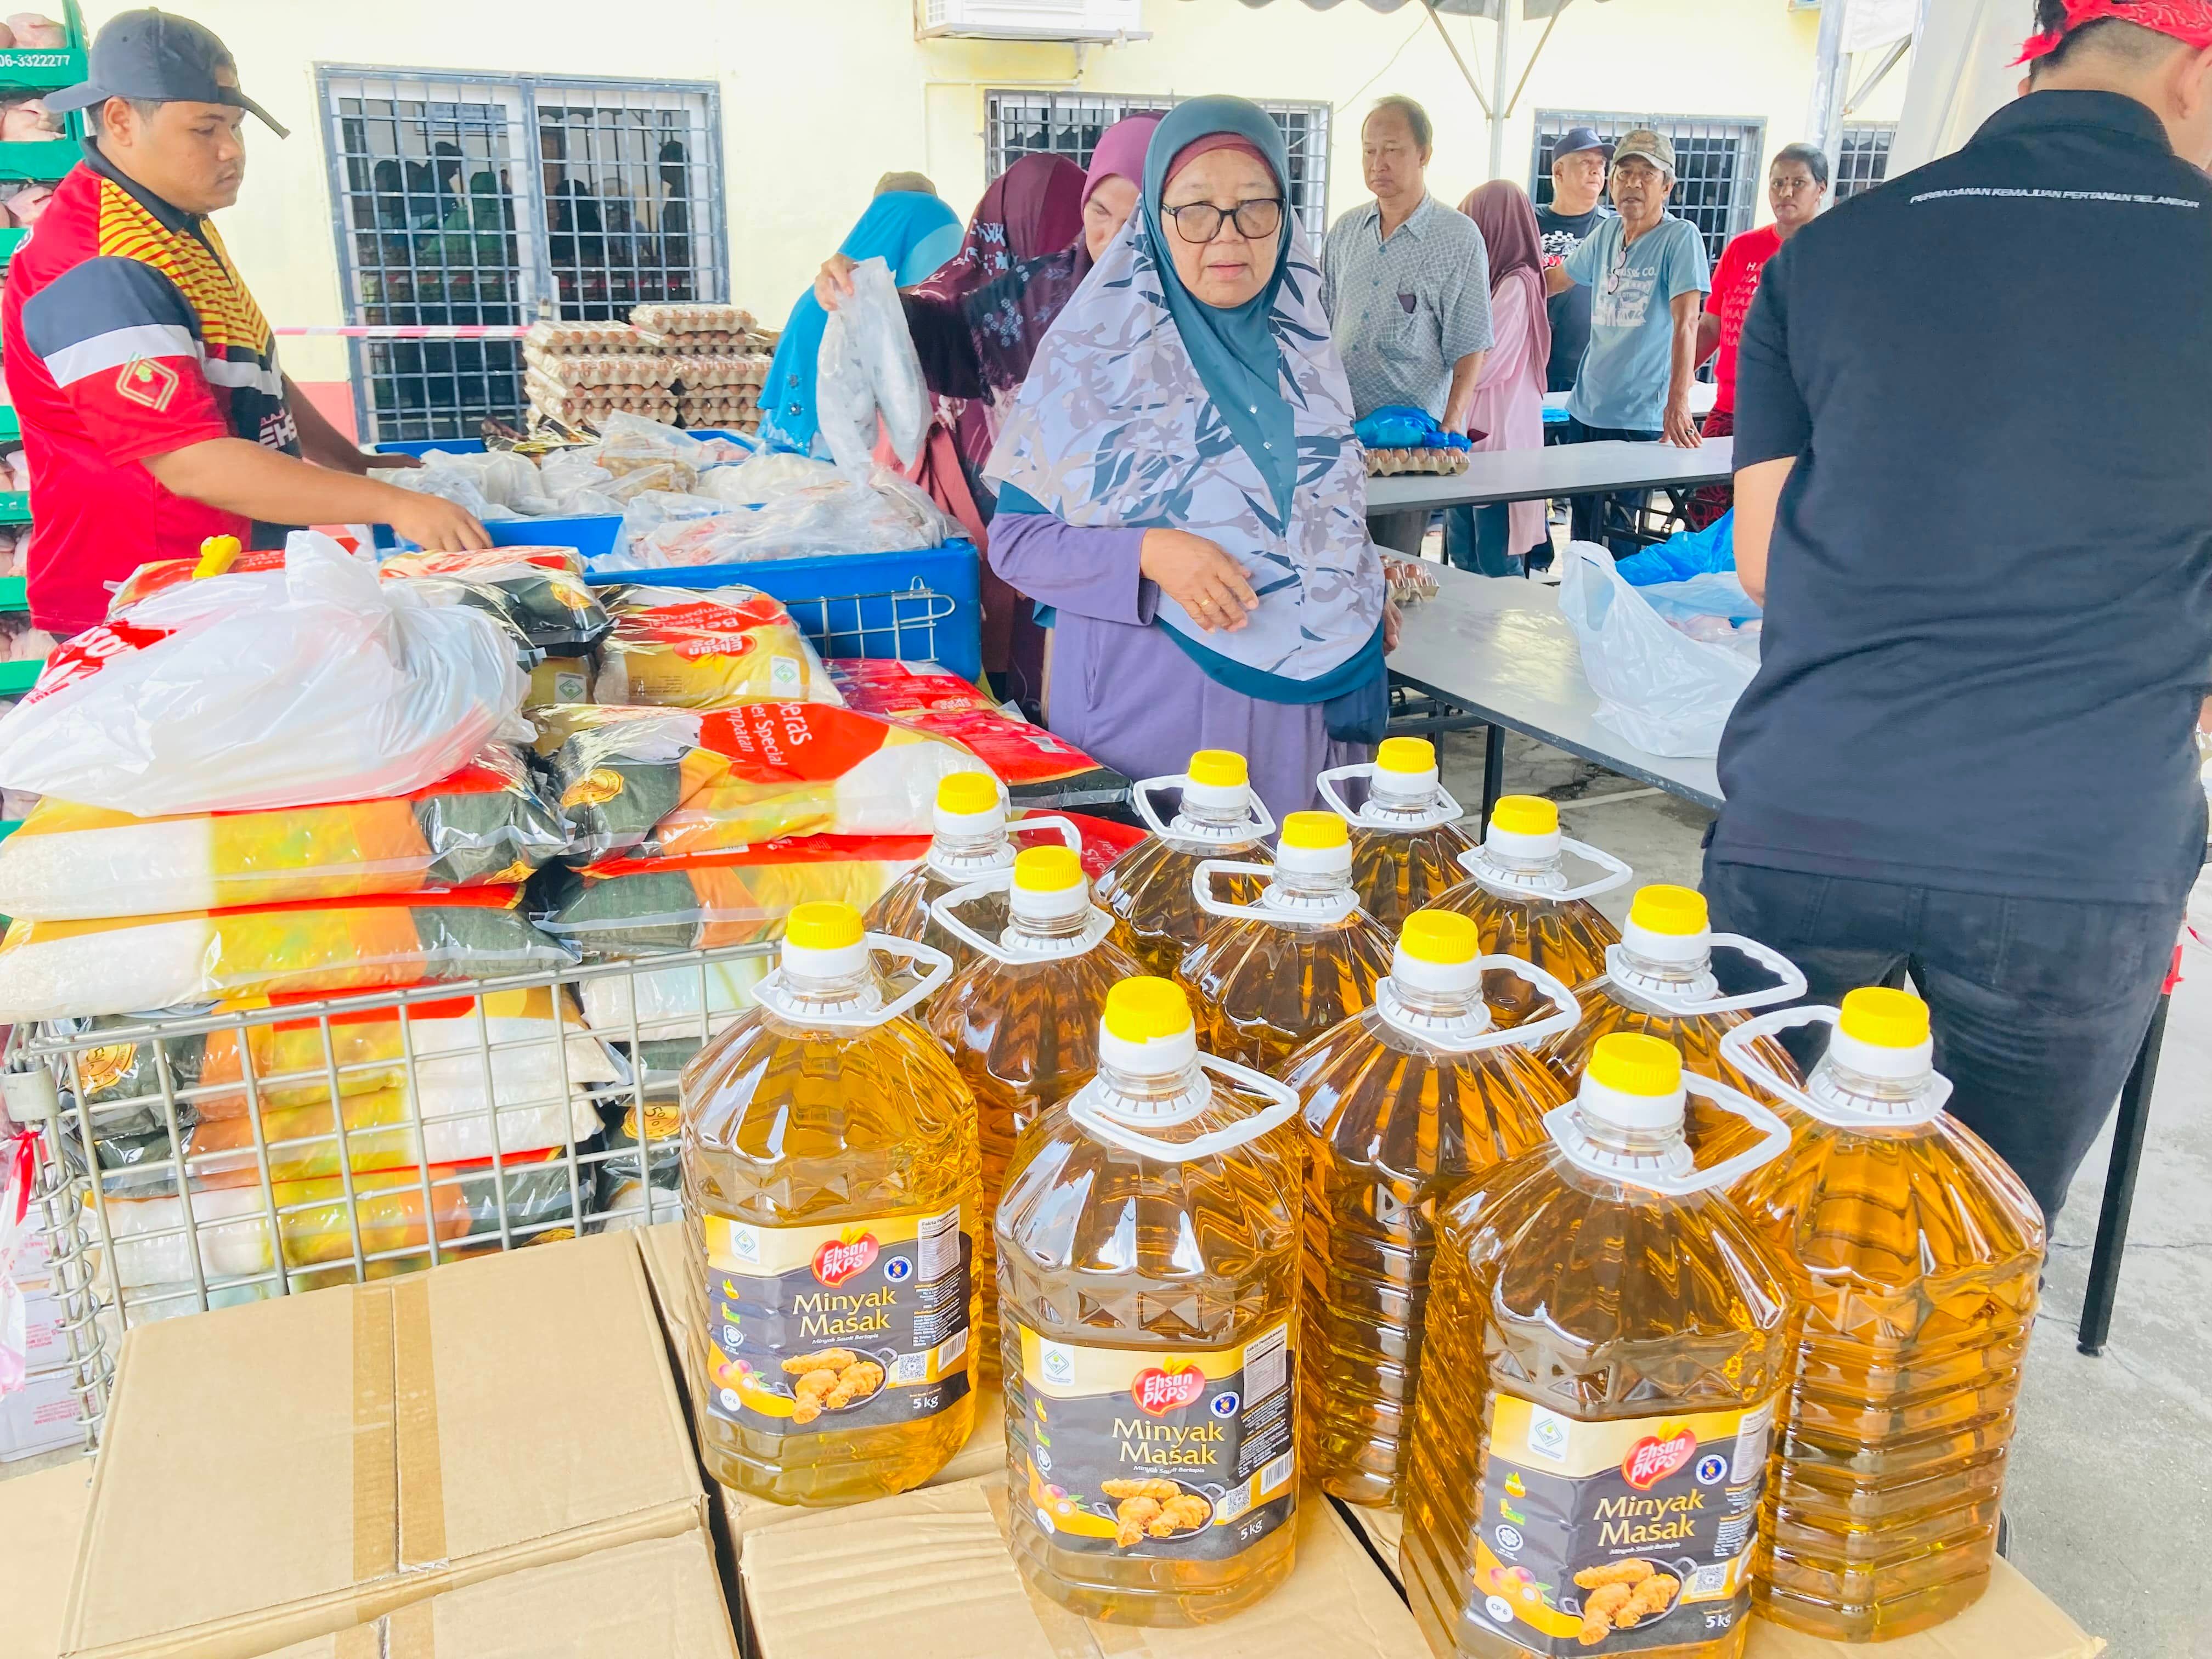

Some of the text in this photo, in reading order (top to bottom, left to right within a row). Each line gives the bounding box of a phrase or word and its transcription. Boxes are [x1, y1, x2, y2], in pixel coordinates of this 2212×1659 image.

[1910, 188, 2200, 208] PERBADANAN KEMAJUAN PERTANIAN SELANGOR
[659, 606, 727, 622] empatan
[688, 640, 743, 656] Ehsan
[751, 703, 788, 766] er Special
[645, 1106, 668, 1126] 5%
[823, 1241, 868, 1264] Ehsan
[822, 1255, 864, 1282] PKPS
[793, 1285, 898, 1316] Minyak
[799, 1308, 891, 1338] Masak
[1144, 1373, 1193, 1392] Ehsan
[913, 1395, 939, 1409] 5 kg
[1142, 1386, 1189, 1408] PKPS
[1111, 1418, 1225, 1448] Minyak
[1119, 1441, 1218, 1465] Masak
[1634, 1437, 1686, 1464] Ehsan
[1133, 1465, 1158, 1474] Minyak
[1630, 1452, 1679, 1483] PKPS
[1593, 1488, 1706, 1522] Minyak
[1240, 1520, 1263, 1541] 5 kg
[1598, 1514, 1696, 1547] Masak
[1705, 1613, 1732, 1628] 5 kg
